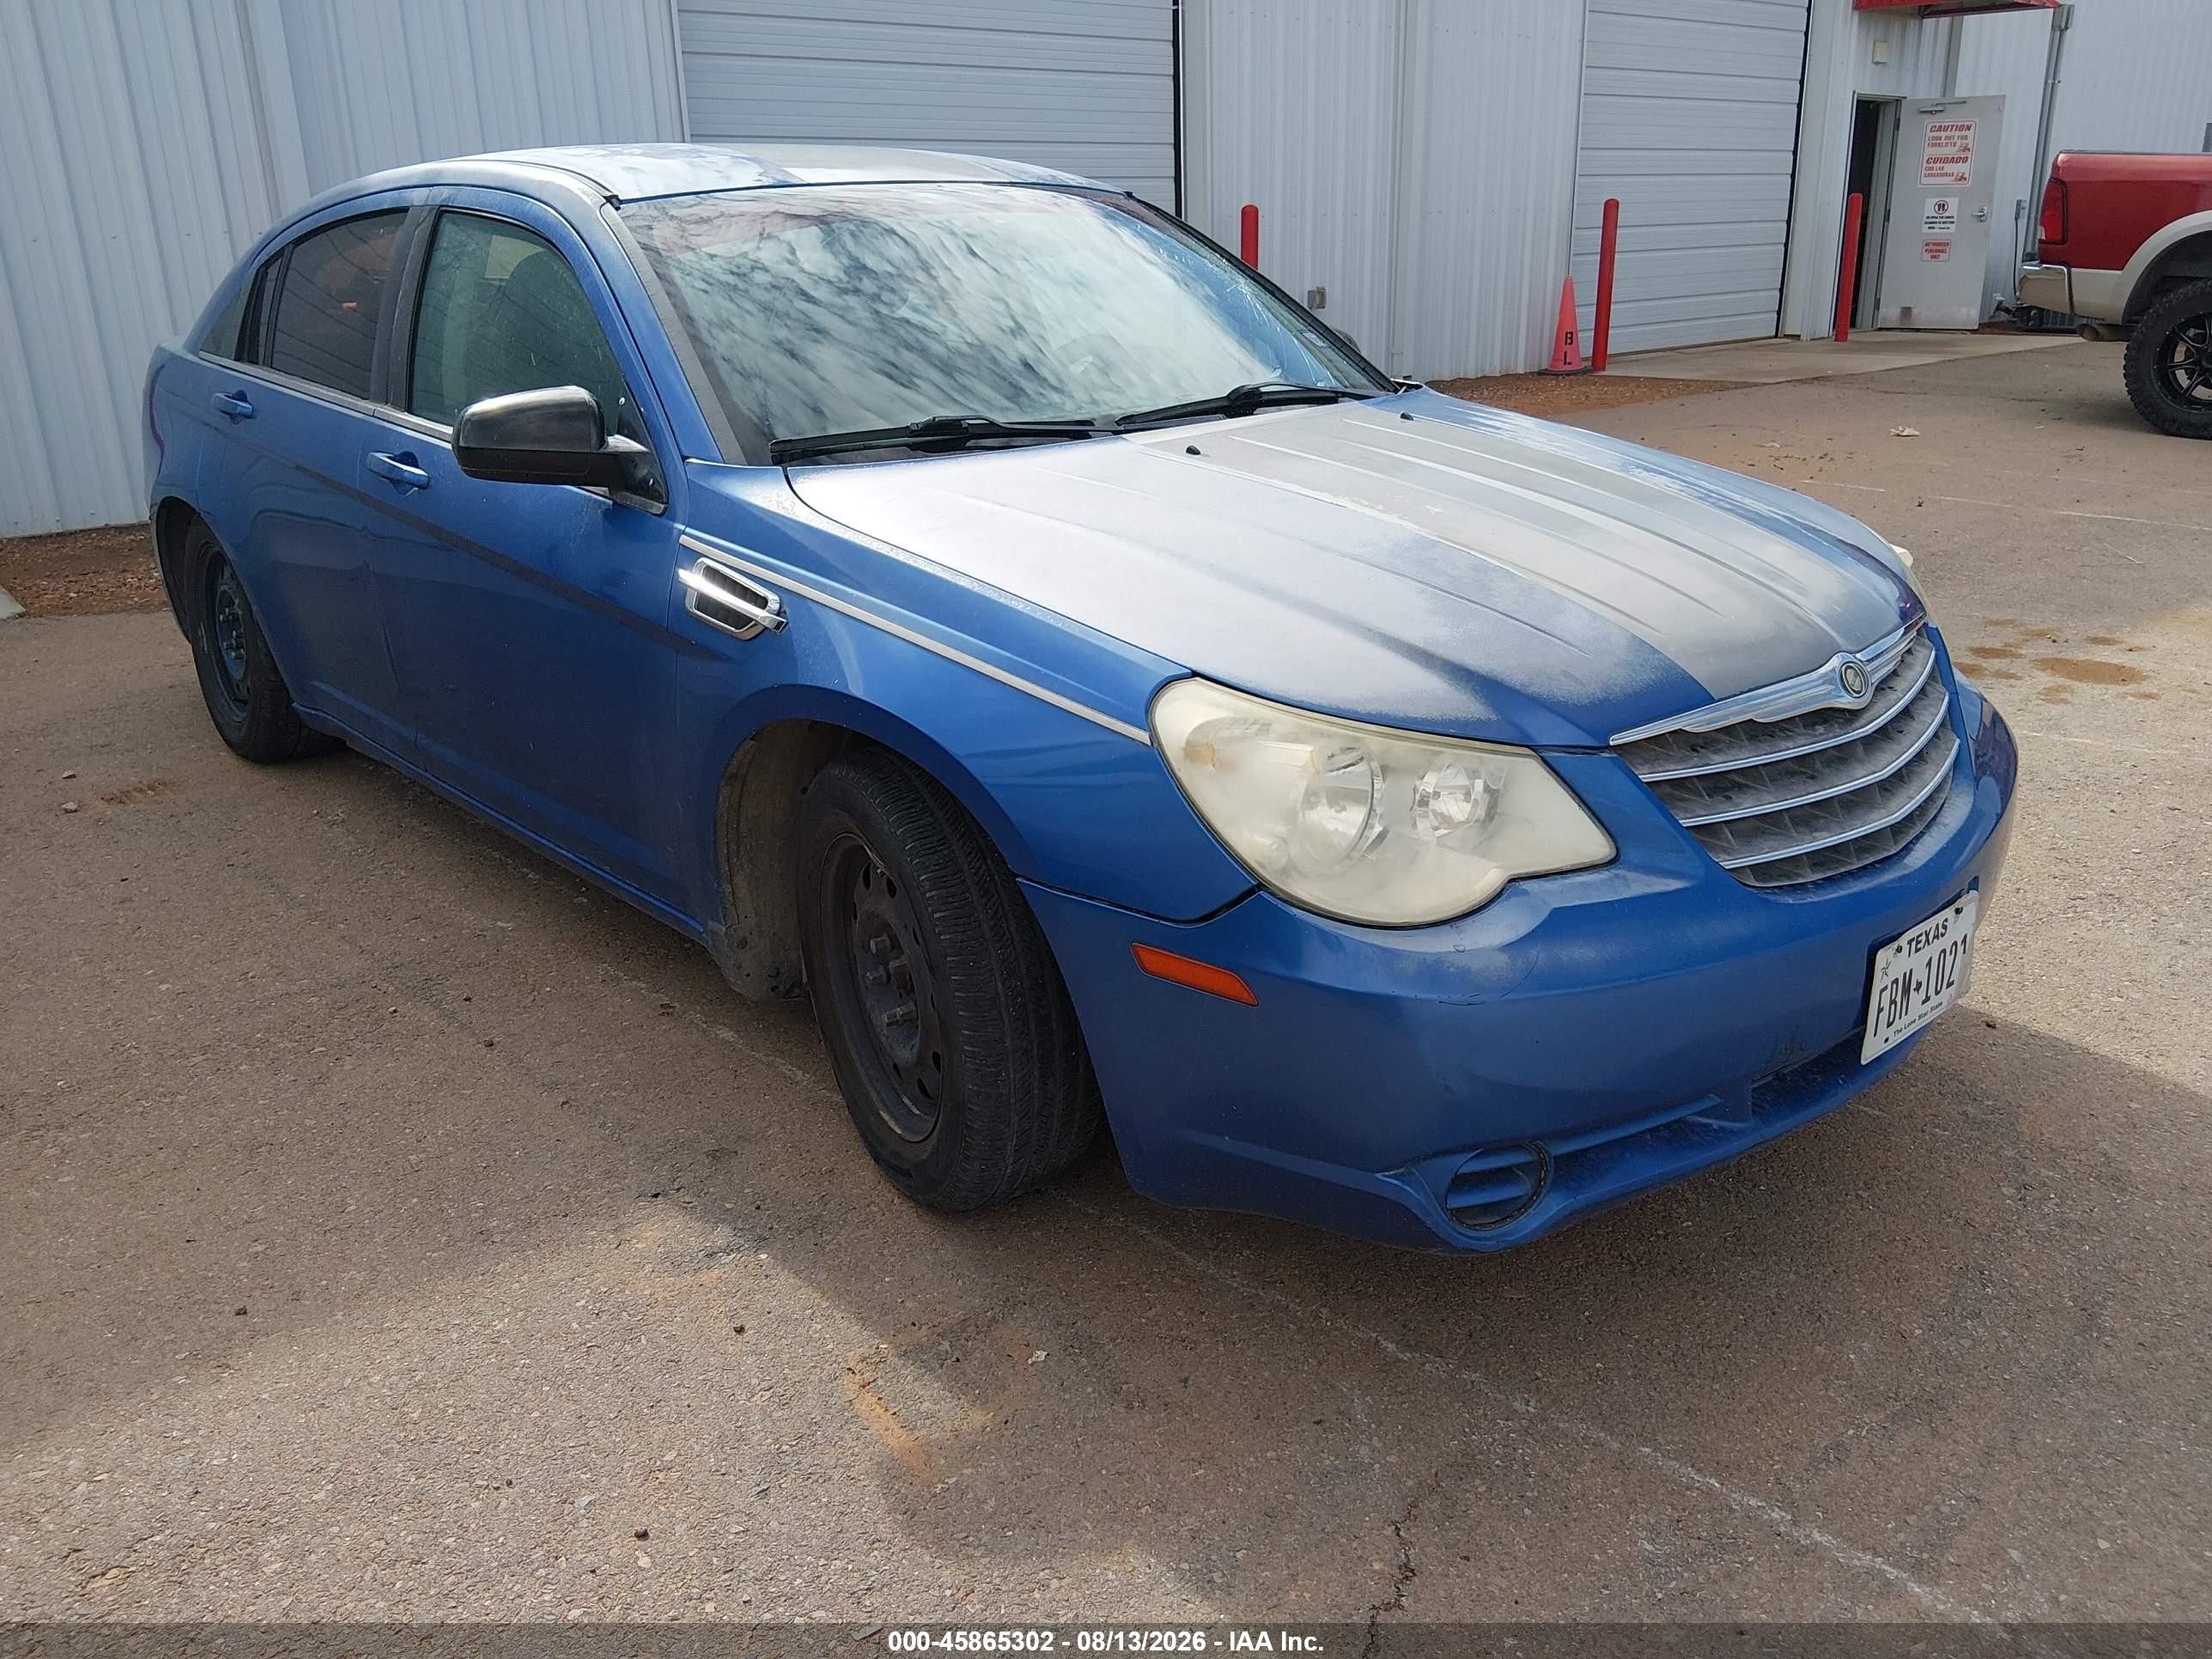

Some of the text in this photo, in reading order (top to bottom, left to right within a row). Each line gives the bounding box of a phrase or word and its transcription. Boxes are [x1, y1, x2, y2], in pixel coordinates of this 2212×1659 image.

[1929, 124, 1972, 132] CAUTION
[1906, 917, 1949, 957] TEXAS
[1893, 1001, 1943, 1037] The Lone Star State
